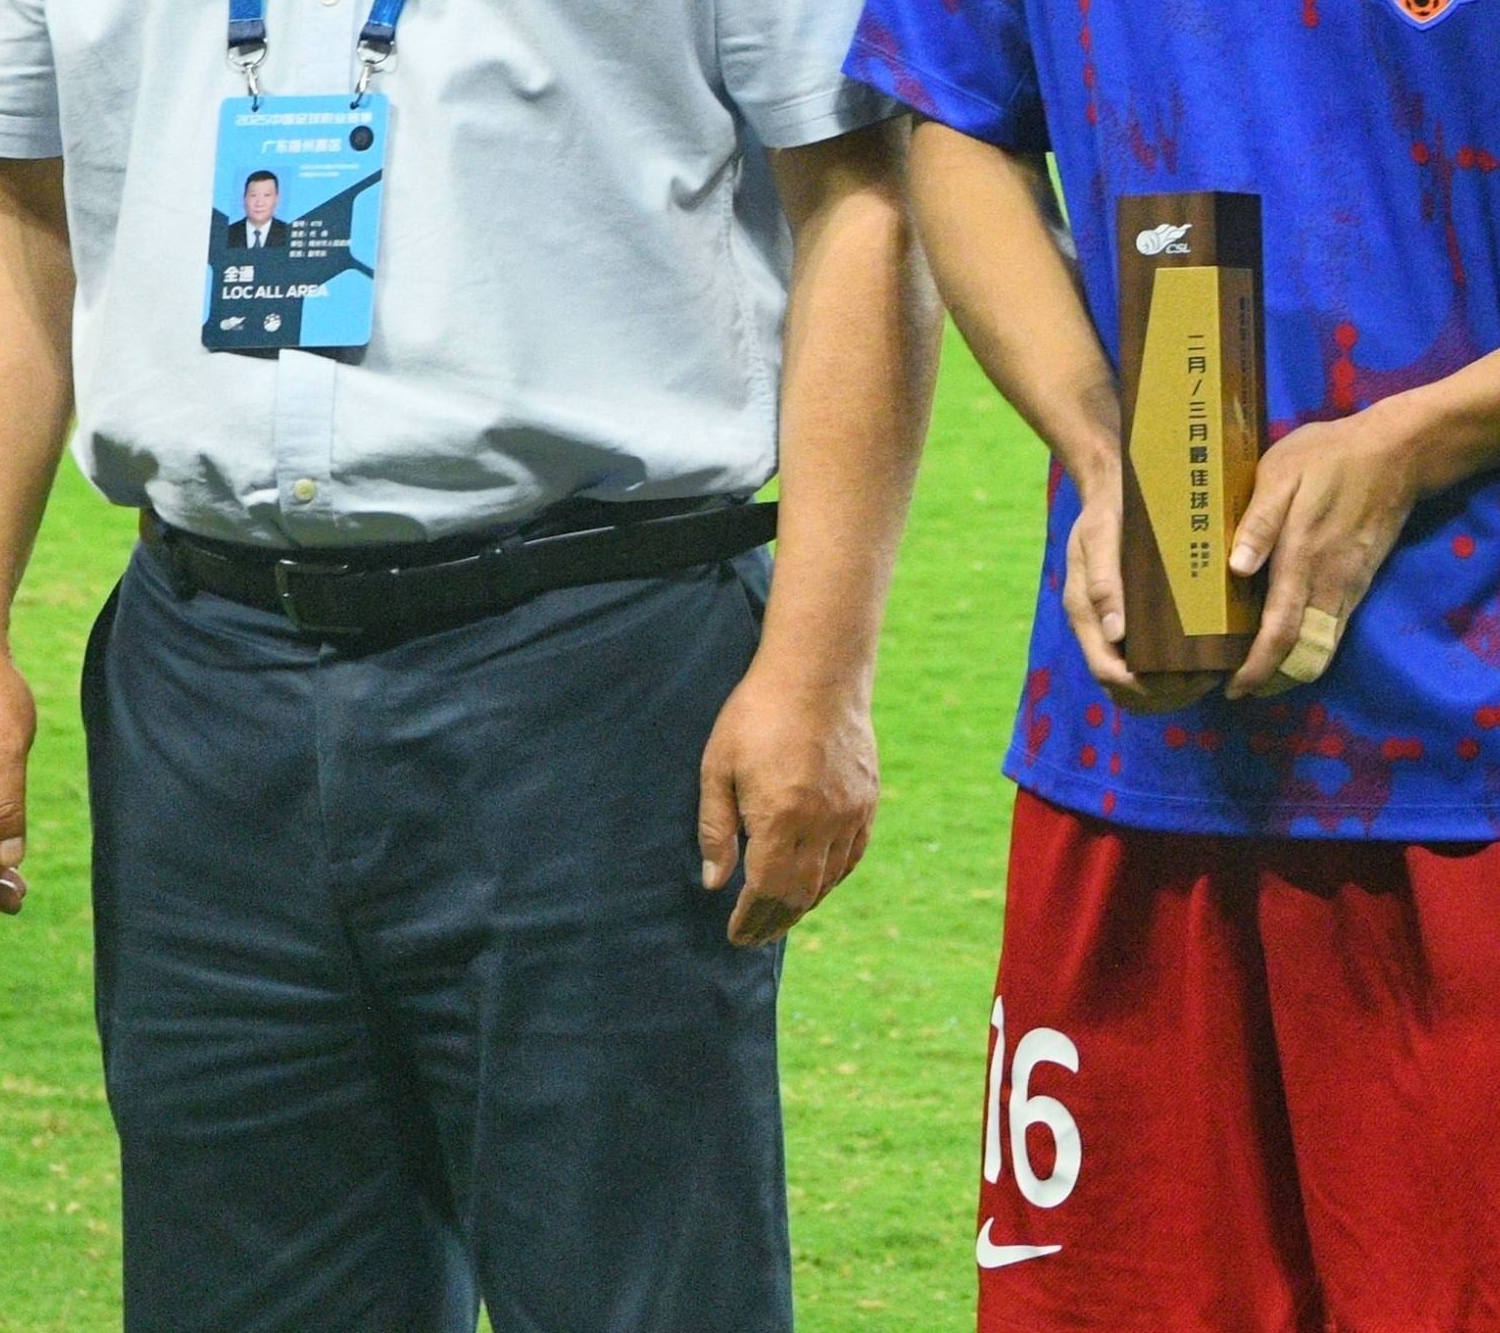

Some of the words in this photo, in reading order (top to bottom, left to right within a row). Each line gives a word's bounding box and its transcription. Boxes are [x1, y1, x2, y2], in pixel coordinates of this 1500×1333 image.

[222, 285, 253, 300] LOC
[254, 285, 284, 299] ALL
[286, 284, 329, 299] AREA
[1165, 242, 1192, 254] CSL
[1187, 334, 1210, 533] 二月/三月最佳球员
[984, 995, 1082, 1209] 16
